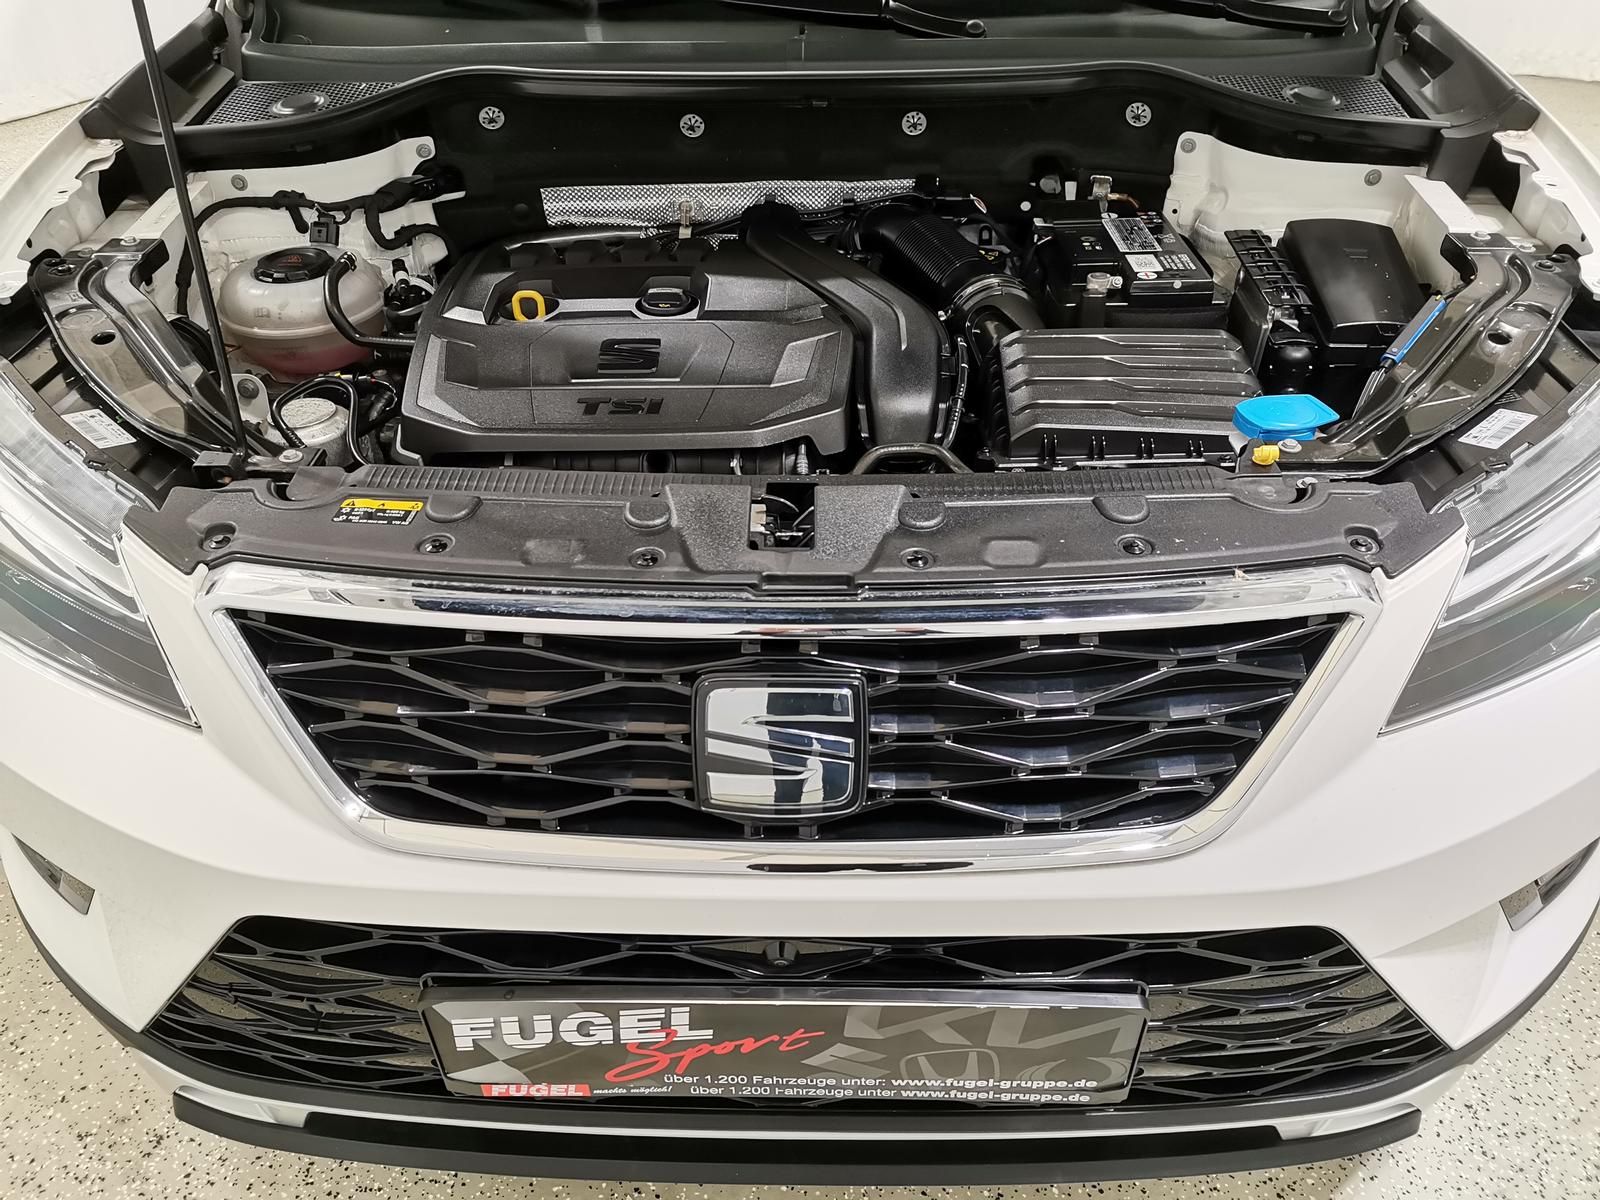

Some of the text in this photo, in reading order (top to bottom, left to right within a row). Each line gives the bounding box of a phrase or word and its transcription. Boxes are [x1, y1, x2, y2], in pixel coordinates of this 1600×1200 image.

[577, 398, 664, 415] TSI
[451, 1007, 713, 1051] FUGEL
[604, 1028, 825, 1082] Sport
[663, 1073, 1098, 1089] über 1.200 Fahrzeuge unter: www.fugel-gruppe.de
[490, 1084, 584, 1097] FUGEL
[689, 1084, 725, 1095] über
[729, 1086, 771, 1096] 1.200
[900, 1089, 1091, 1103] www.fugel-gruppe.de
